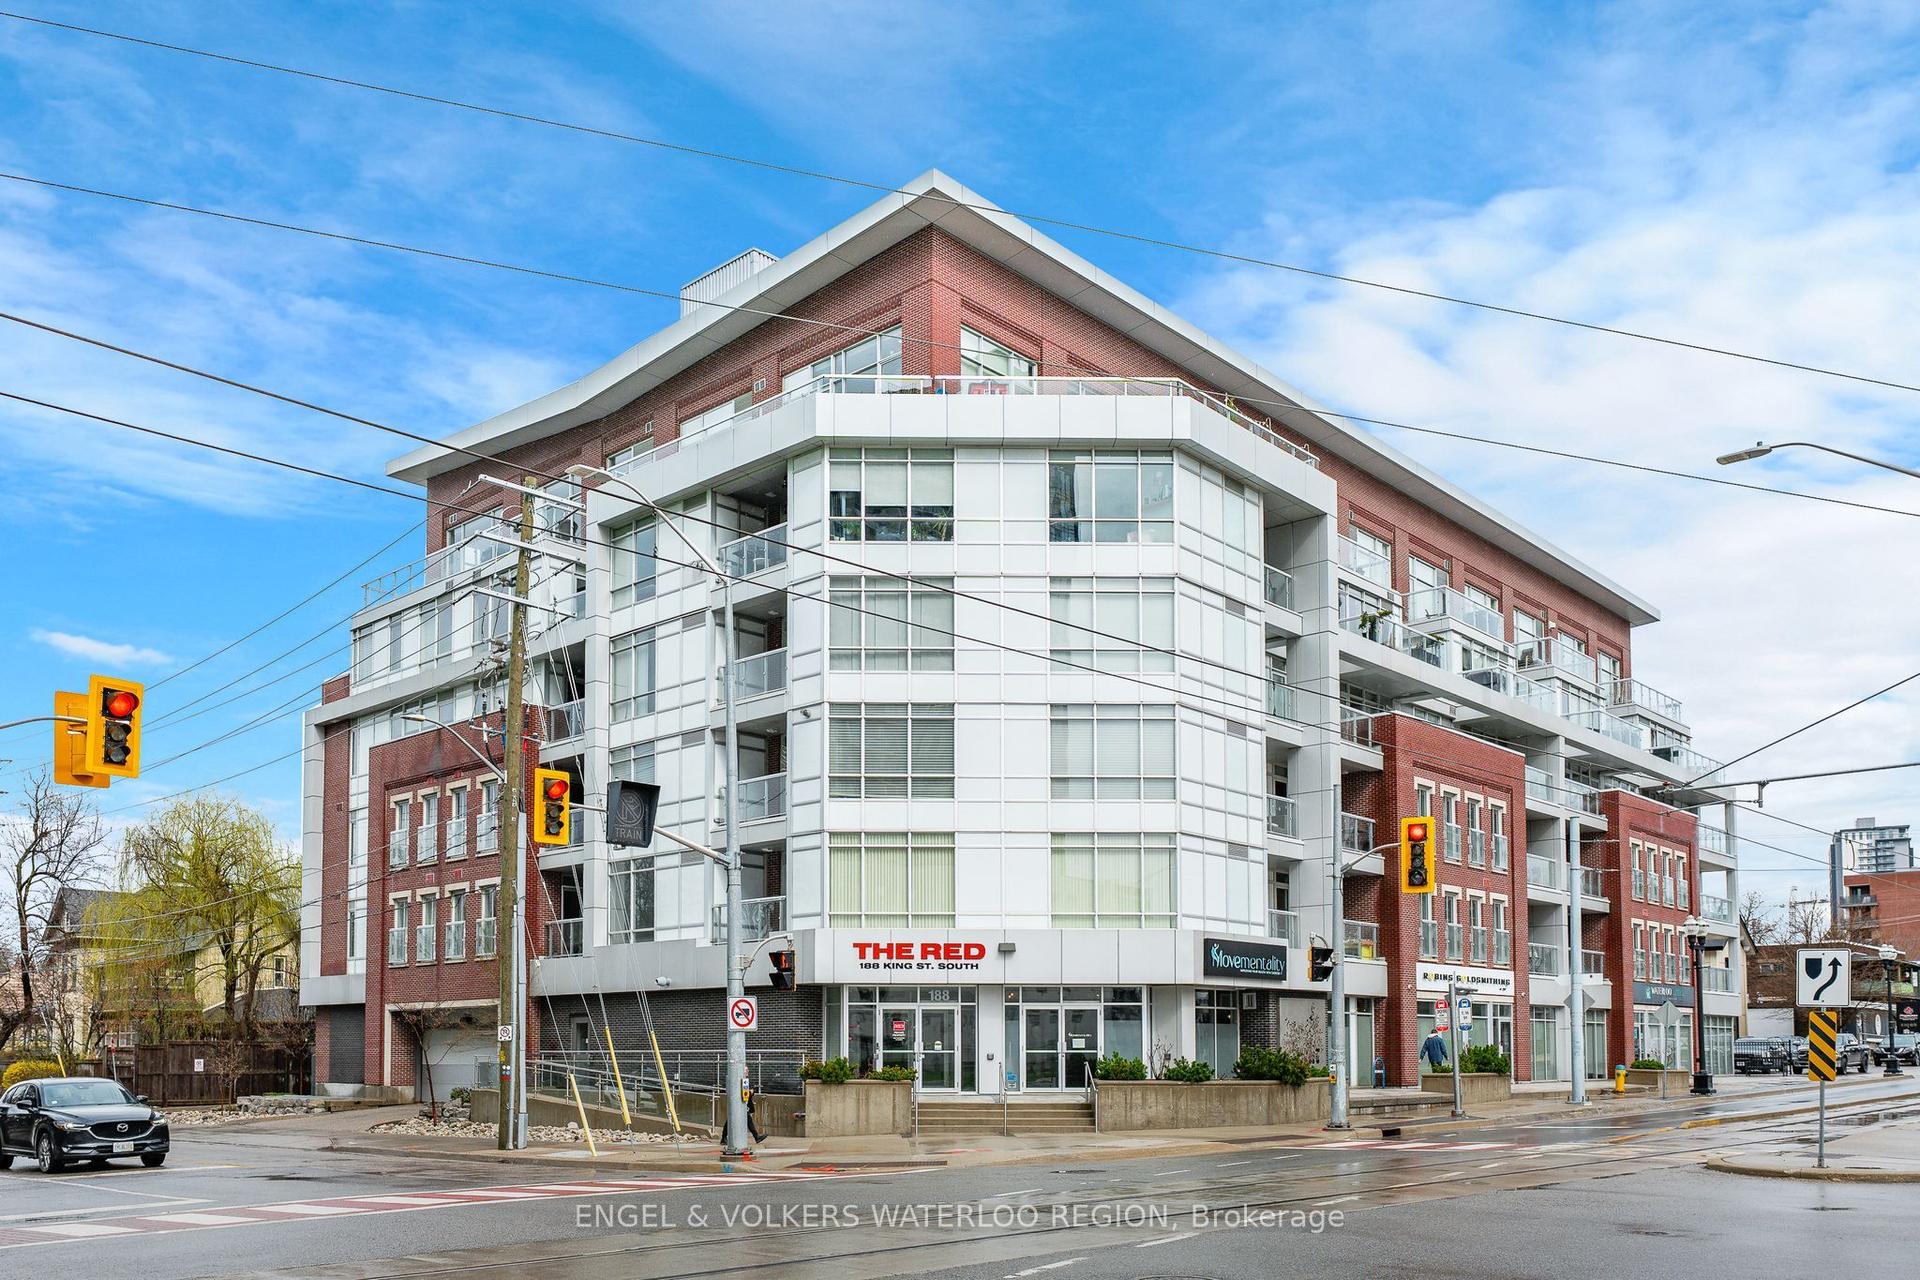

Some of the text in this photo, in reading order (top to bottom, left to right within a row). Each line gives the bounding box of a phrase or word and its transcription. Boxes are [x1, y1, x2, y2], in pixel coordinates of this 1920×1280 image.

[615, 827, 642, 840] TRAIN
[853, 942, 986, 960] THE RED
[1211, 943, 1285, 972] Movementality
[928, 989, 951, 1001] 188
